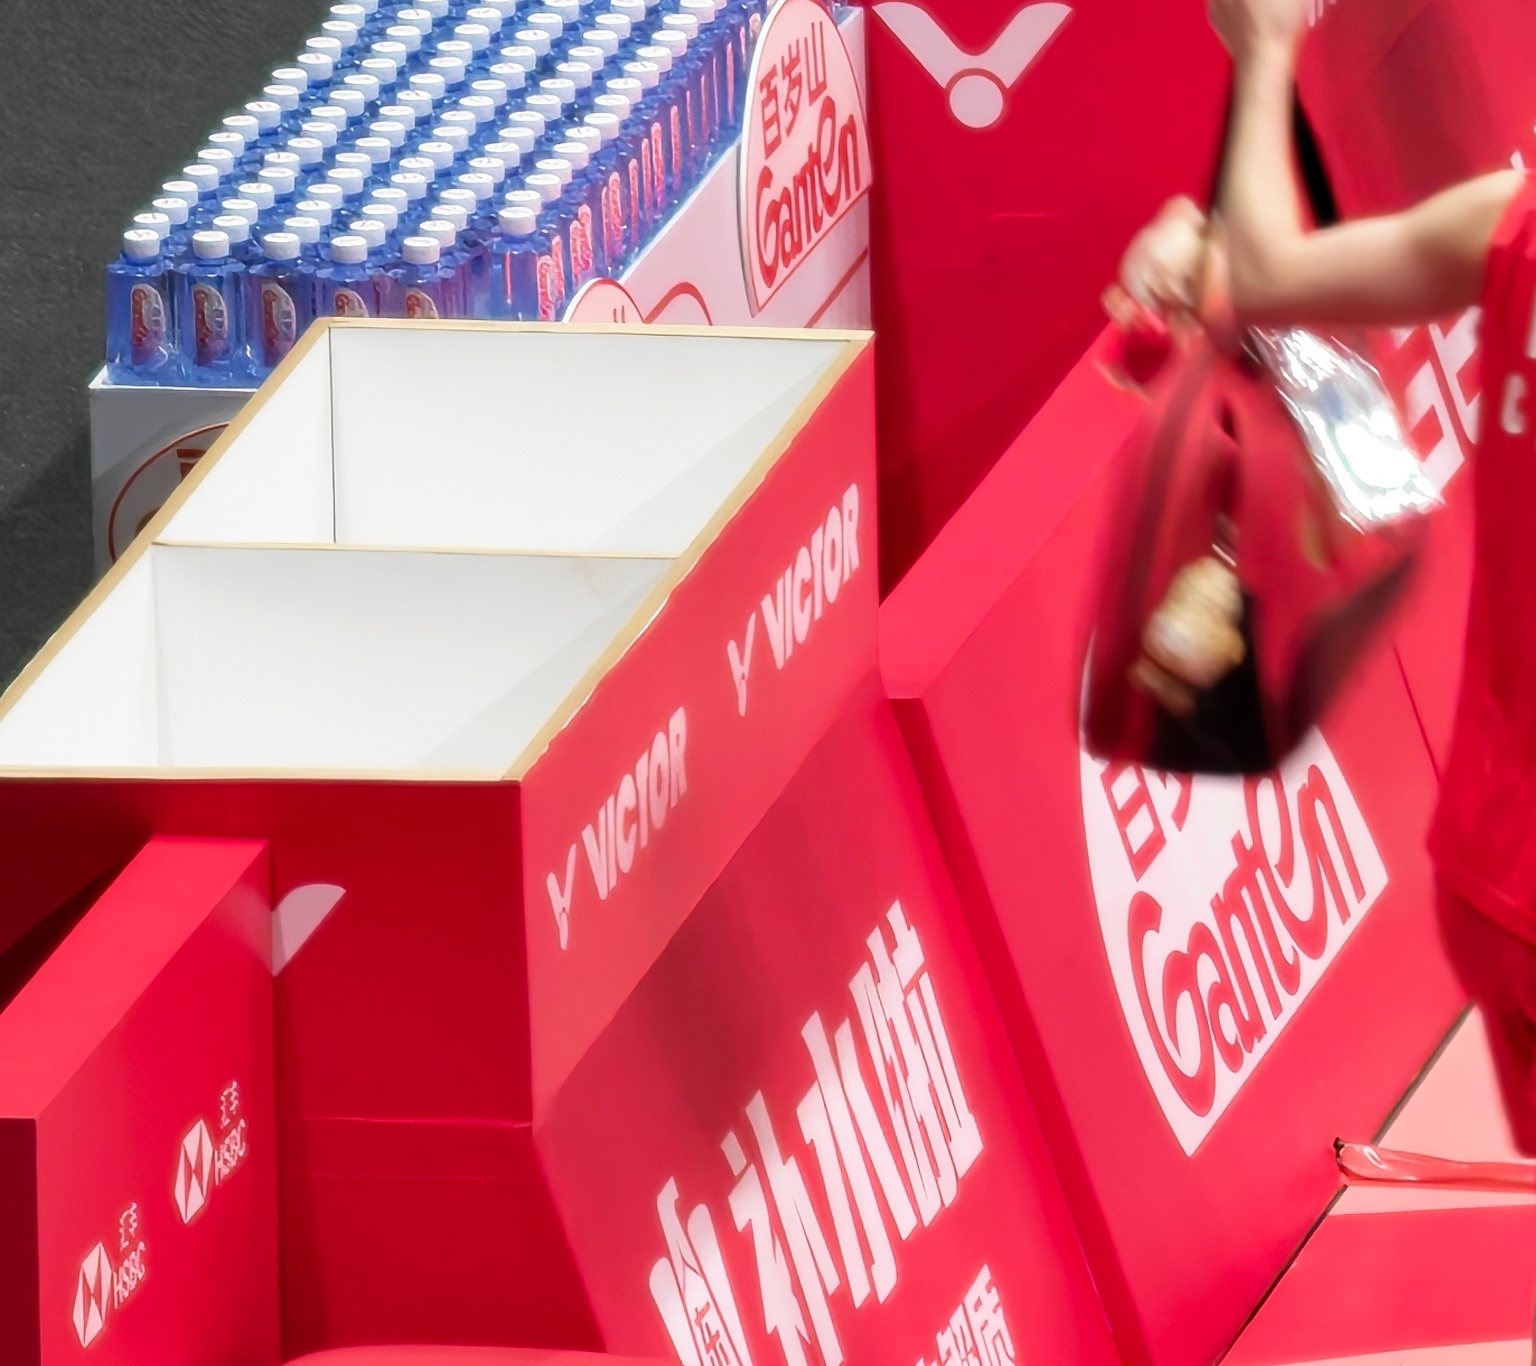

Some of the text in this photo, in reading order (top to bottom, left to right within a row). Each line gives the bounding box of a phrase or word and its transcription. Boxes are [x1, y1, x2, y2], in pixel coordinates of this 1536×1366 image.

[759, 20, 828, 160] 百岁山
[755, 95, 862, 289] Ganten
[760, 482, 861, 672] VICTOR
[581, 705, 688, 902] VICTOR
